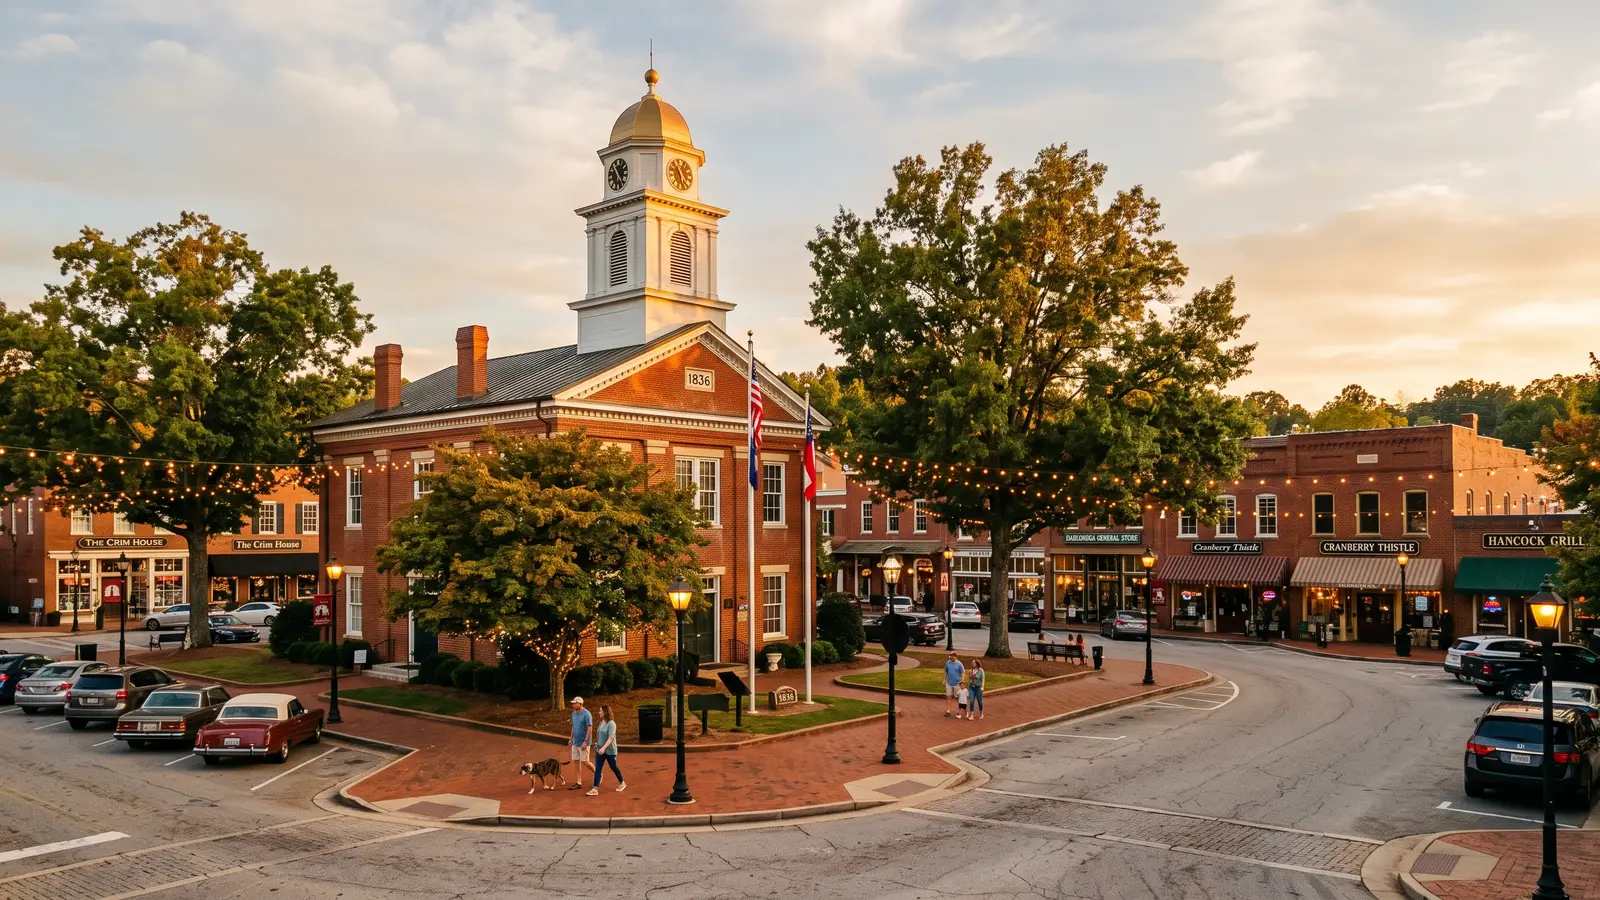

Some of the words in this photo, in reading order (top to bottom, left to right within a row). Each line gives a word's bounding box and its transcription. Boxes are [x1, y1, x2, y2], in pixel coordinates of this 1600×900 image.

[689, 374, 710, 386] 1836
[1488, 536, 1545, 545] HANCOCK
[1550, 536, 1584, 545] GRILL
[1194, 544, 1231, 552] Cranberry
[1324, 543, 1374, 551] CRANBERRY
[1378, 543, 1415, 552] THISTLE
